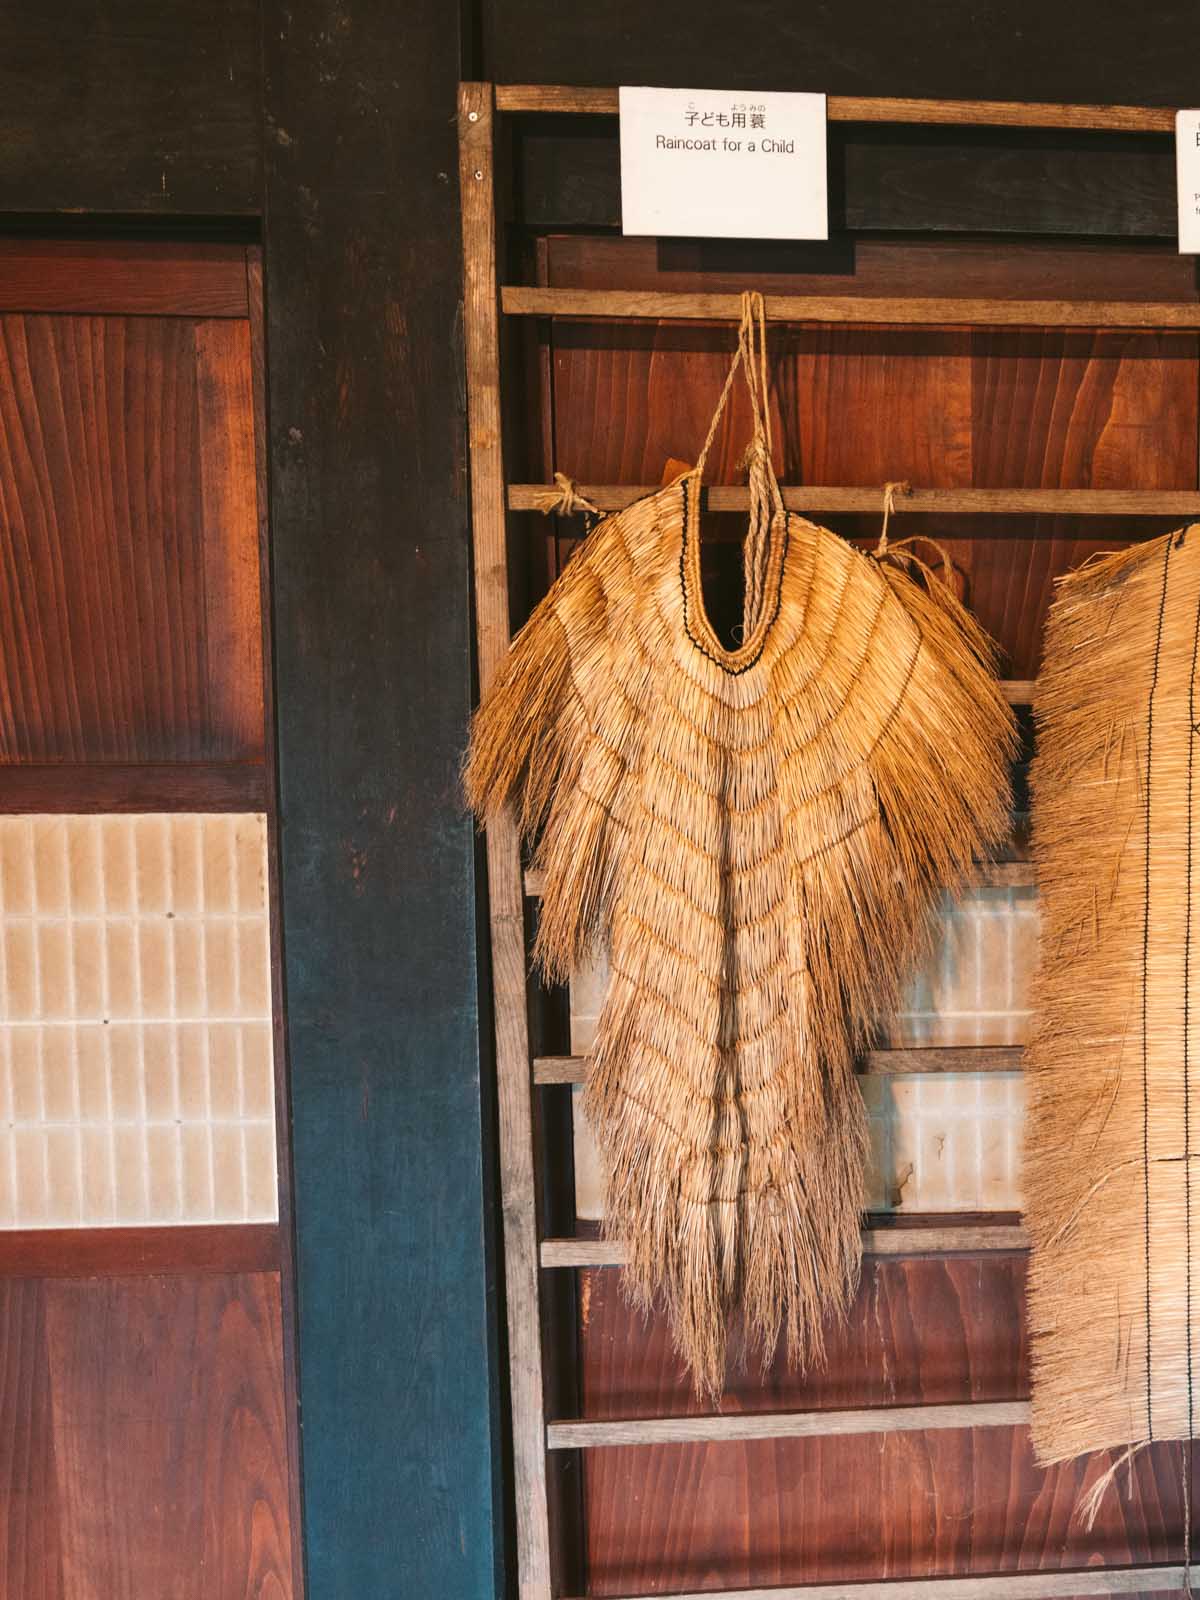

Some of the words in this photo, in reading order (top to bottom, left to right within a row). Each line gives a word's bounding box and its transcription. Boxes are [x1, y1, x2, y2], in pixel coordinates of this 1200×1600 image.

[655, 134, 717, 150] Raincoat
[723, 137, 742, 151] for
[747, 142, 756, 152] a
[761, 138, 795, 153] Child
